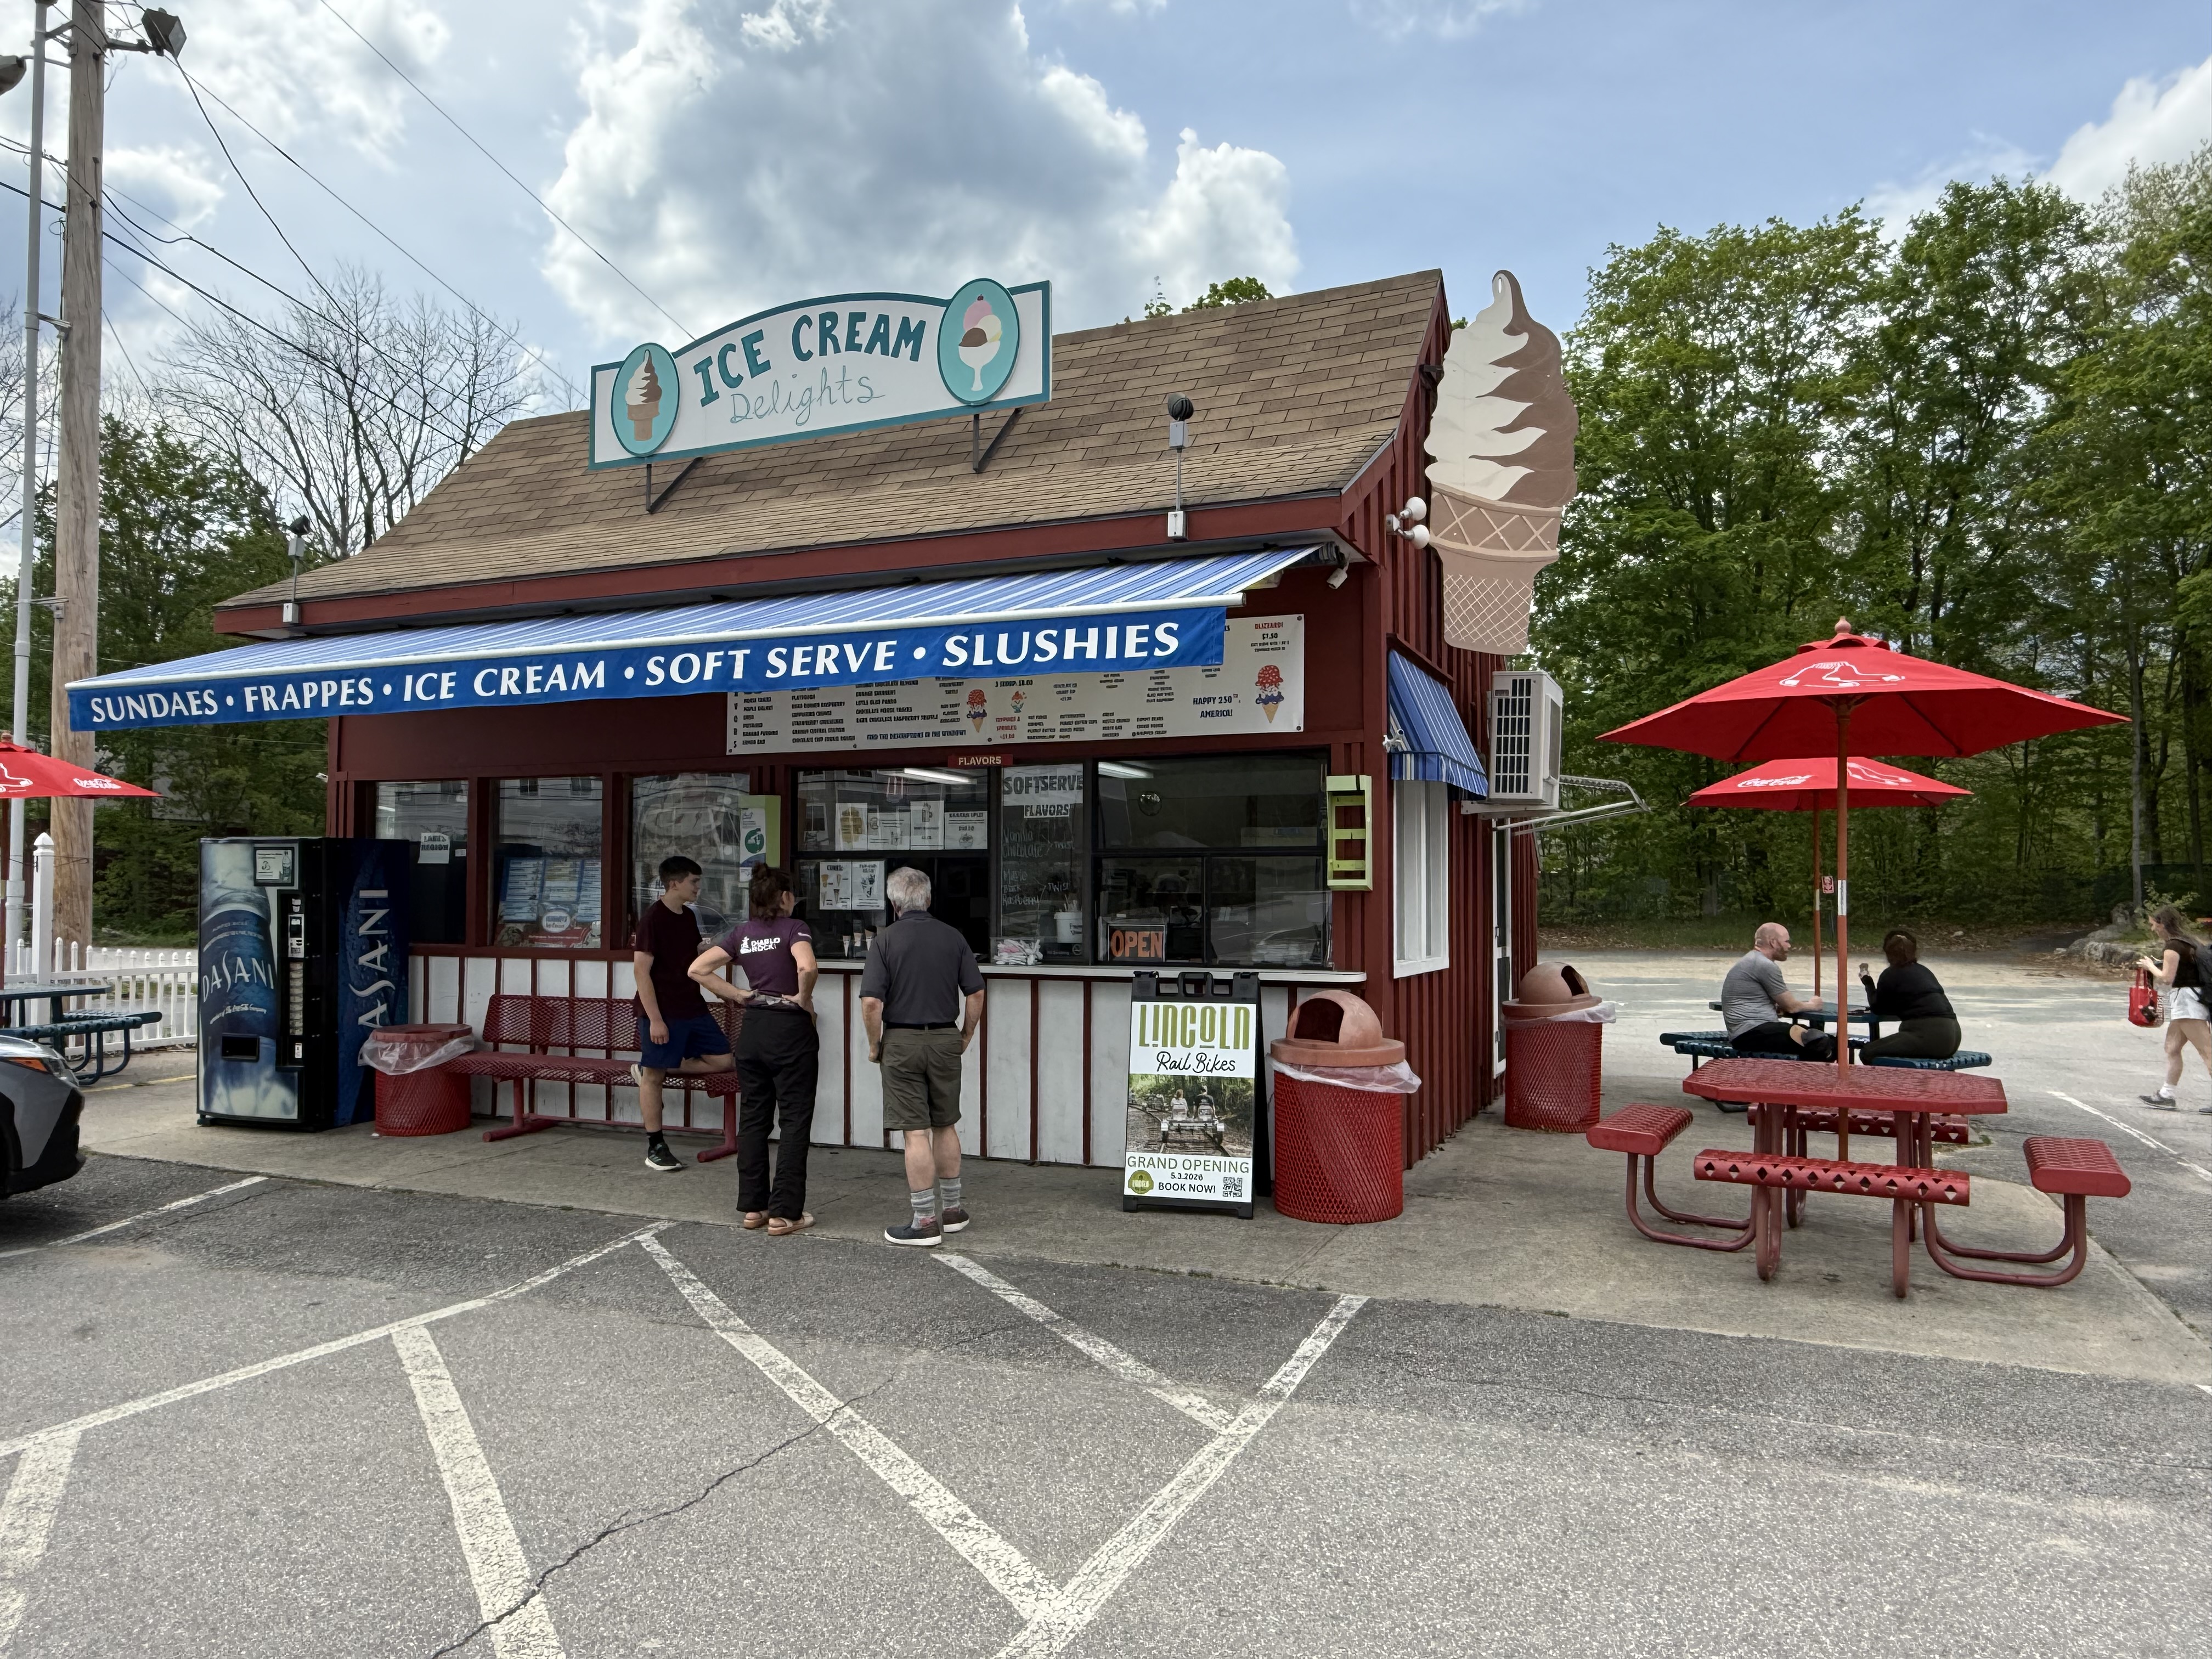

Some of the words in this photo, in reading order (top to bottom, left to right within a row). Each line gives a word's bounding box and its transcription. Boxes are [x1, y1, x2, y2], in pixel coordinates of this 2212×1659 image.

[692, 329, 771, 407] ICE
[792, 311, 927, 363] CREAM
[730, 365, 886, 426] Delights
[91, 689, 218, 723] SUNDAES
[244, 677, 374, 712] FRAPPES
[404, 671, 457, 702] ICE
[473, 661, 605, 696] CREAM
[645, 649, 751, 686] SOFT
[765, 640, 898, 678] SERVE
[942, 622, 1180, 667] SLUSHIES
[1193, 697, 1217, 705] HAPPY
[958, 755, 1002, 766] FLAVORS
[1024, 804, 1069, 817] FLAVORS
[751, 937, 781, 947] DIABLO
[1110, 930, 1164, 958] OPEN
[348, 889, 395, 1028] ASANI
[202, 950, 274, 1003] DASANI
[1138, 1004, 1251, 1050] LINCOLN
[1156, 1051, 1192, 1073] Rail
[1193, 1052, 1236, 1074] Bikes
[1127, 1155, 1178, 1170] GRAND
[1182, 1159, 1249, 1173] OPENING
[1158, 1182, 1186, 1192] BOOK
[1188, 1183, 1216, 1194] NOW!
